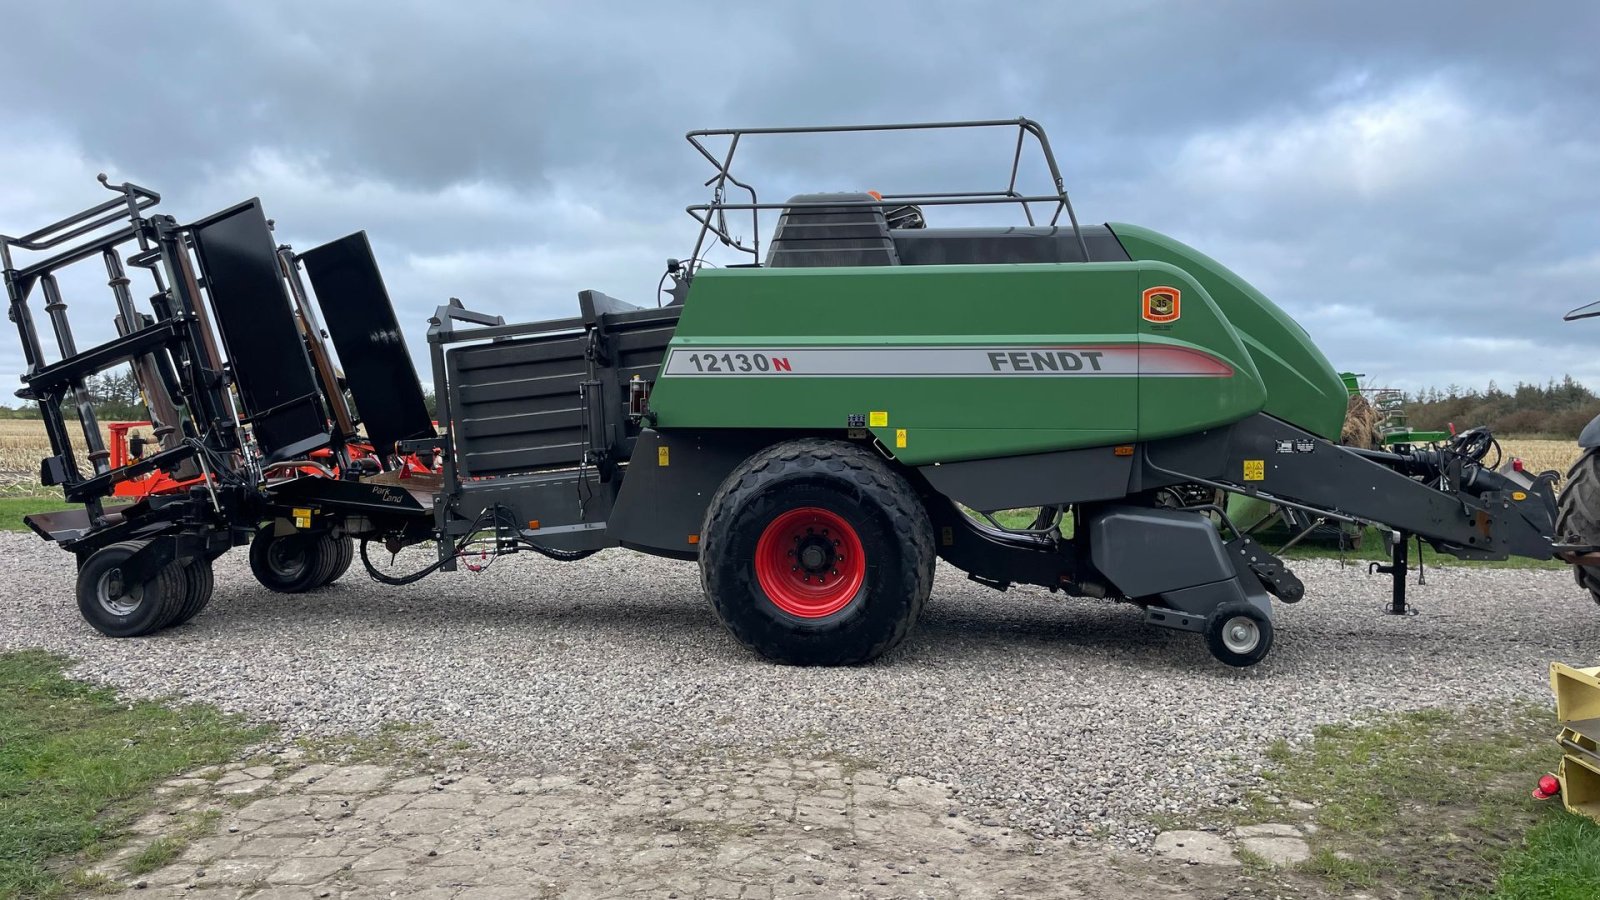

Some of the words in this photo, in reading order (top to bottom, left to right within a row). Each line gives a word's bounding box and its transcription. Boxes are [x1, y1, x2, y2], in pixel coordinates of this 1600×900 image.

[987, 351, 1103, 371] FENDT
[372, 486, 391, 495] Park
[383, 493, 404, 503] Land
